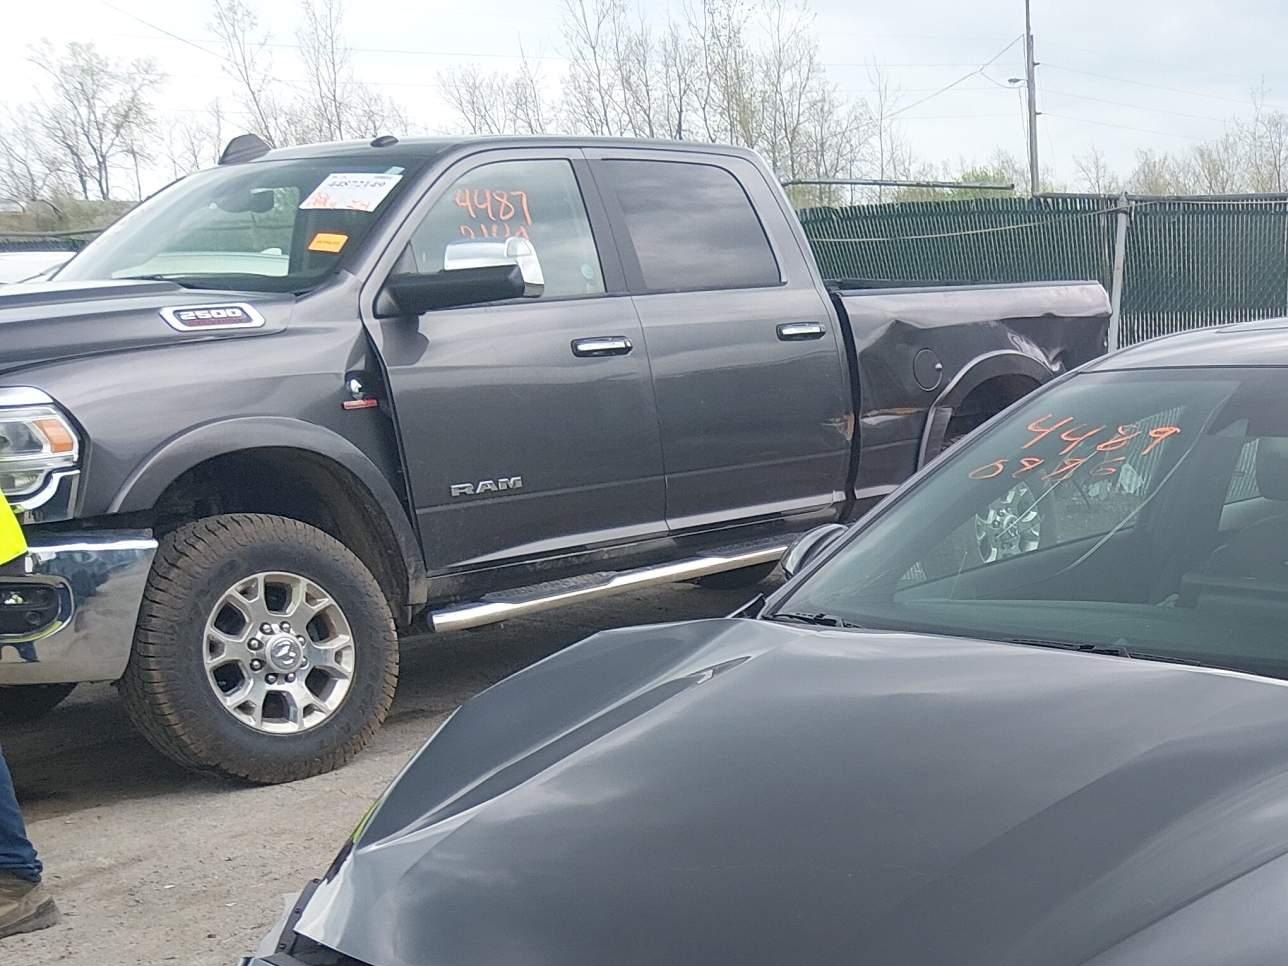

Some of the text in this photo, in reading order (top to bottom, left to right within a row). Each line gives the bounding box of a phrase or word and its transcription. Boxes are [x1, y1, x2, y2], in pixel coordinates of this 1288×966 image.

[455, 189, 532, 225] 4487
[180, 308, 242, 321] 2500
[1021, 414, 1181, 456] 4489
[450, 476, 523, 497] RAM
